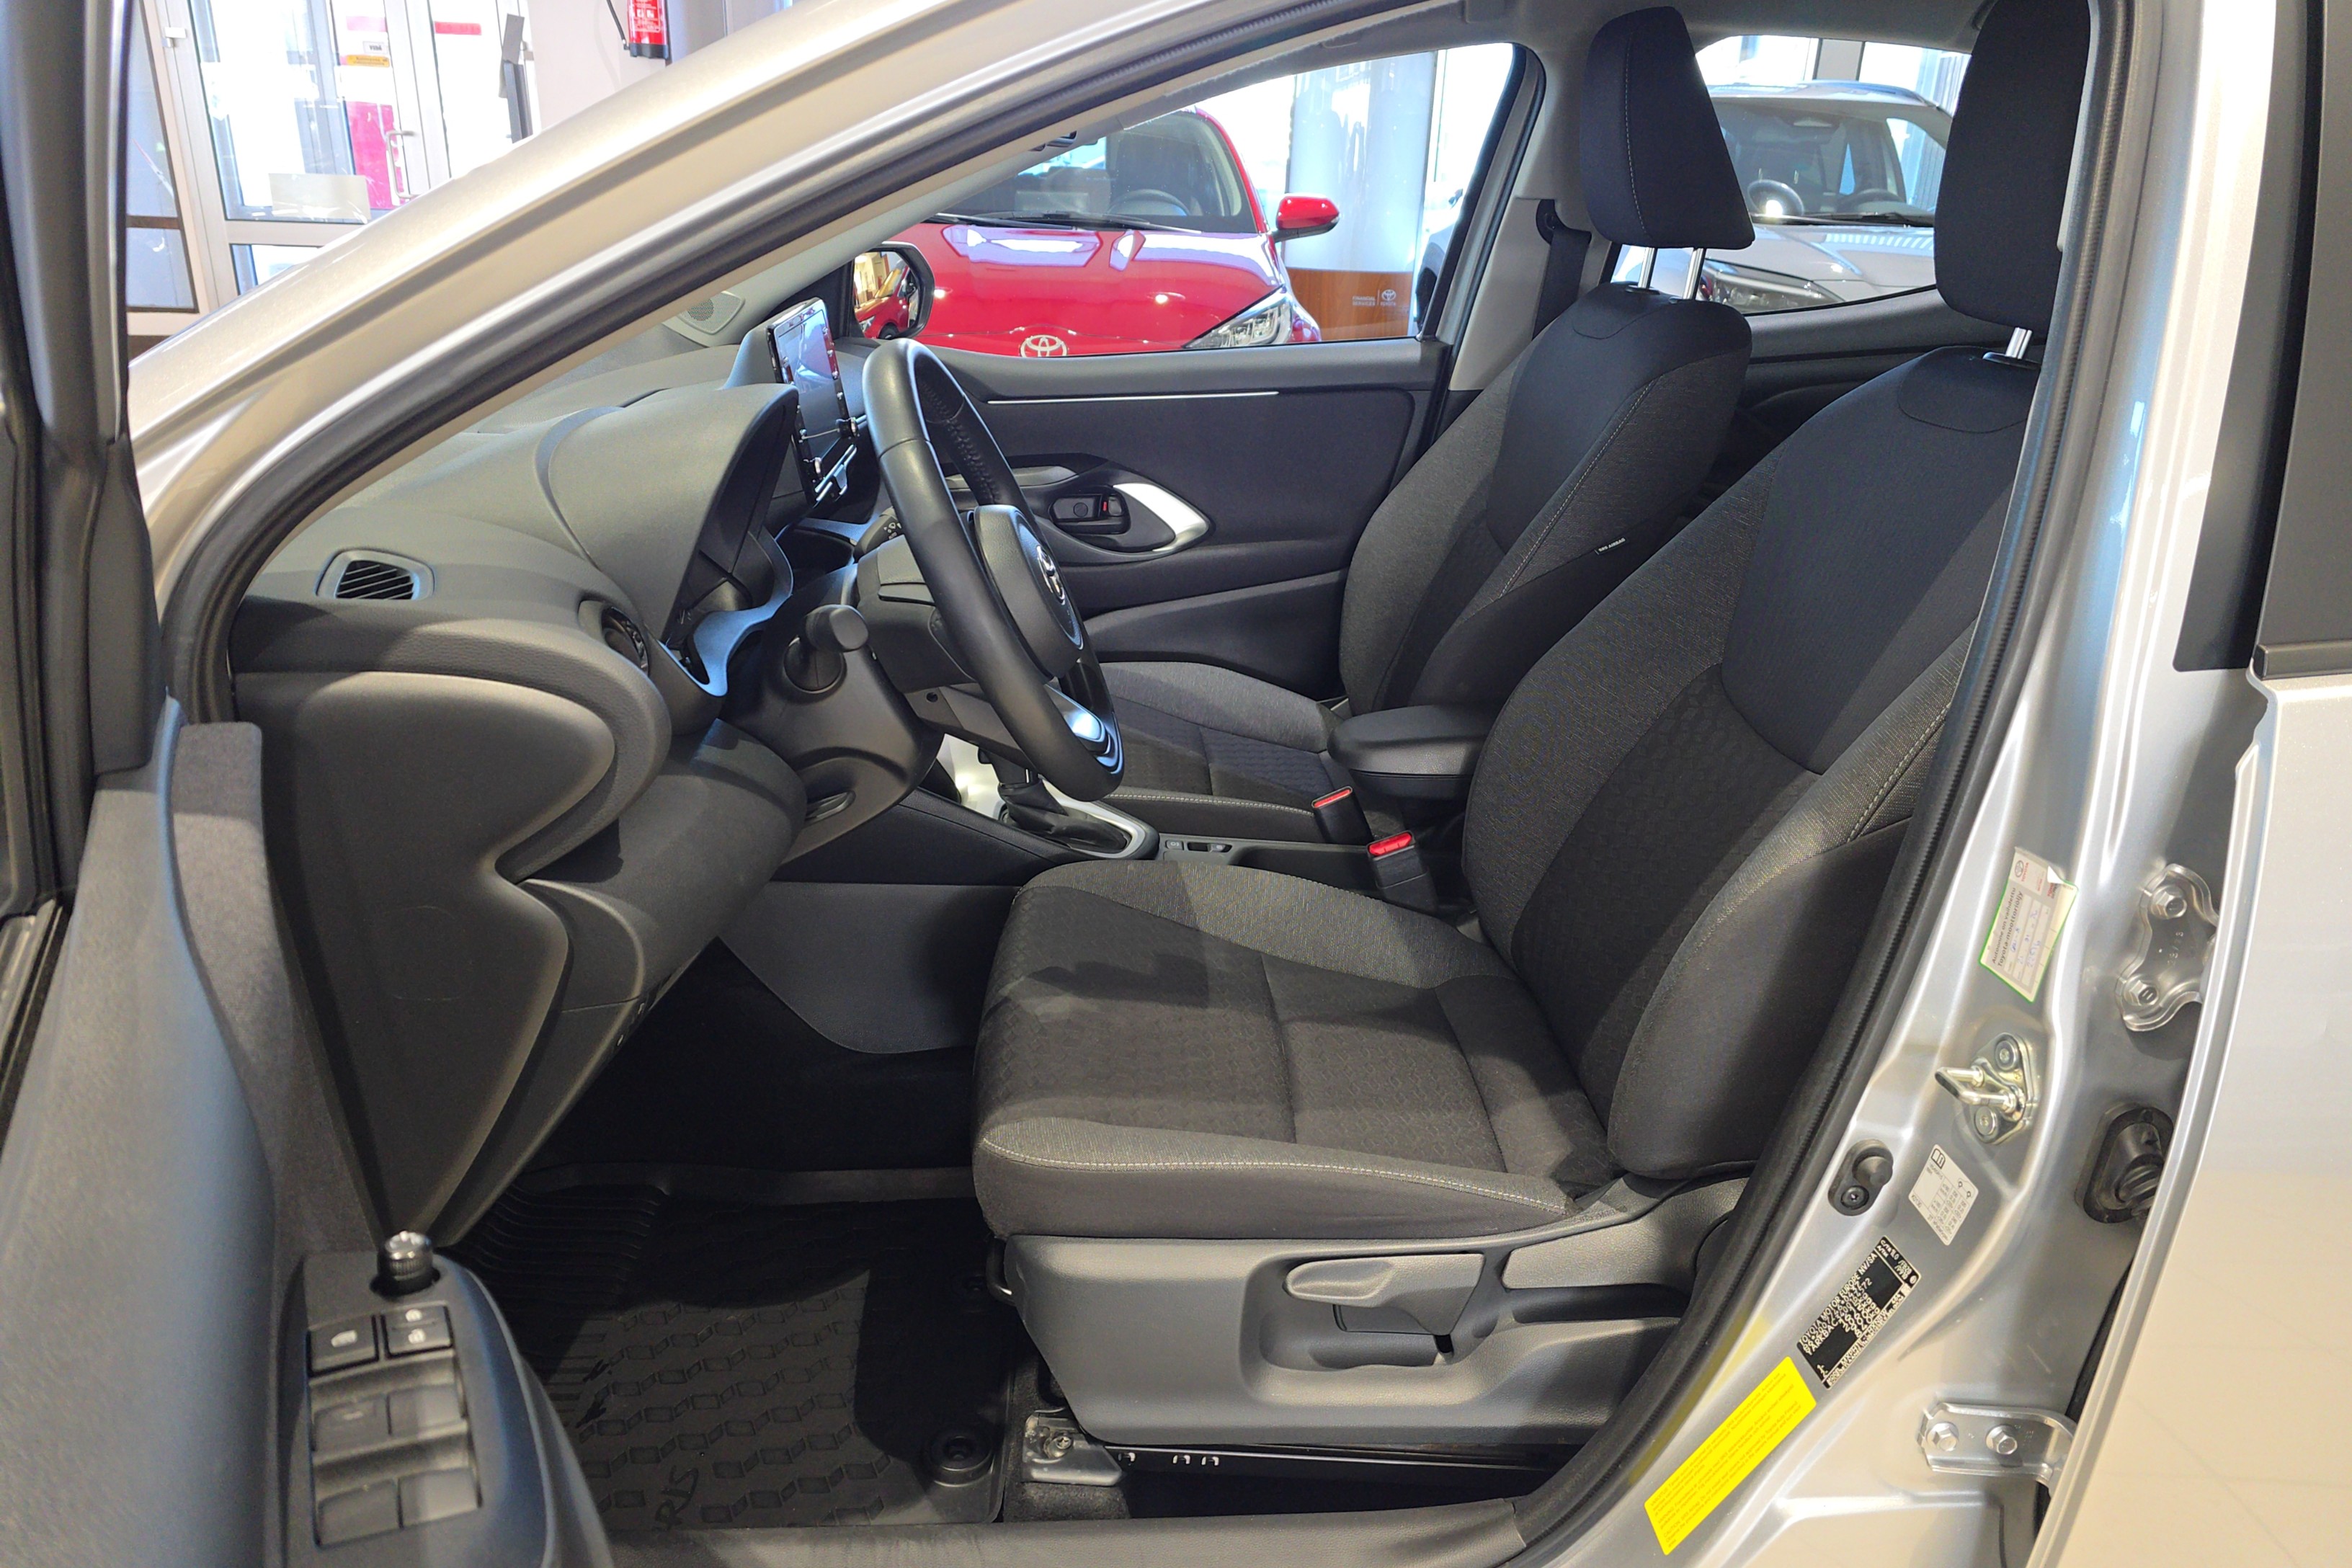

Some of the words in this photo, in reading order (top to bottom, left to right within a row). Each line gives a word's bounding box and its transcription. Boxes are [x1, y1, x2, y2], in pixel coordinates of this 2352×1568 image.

[1800, 1319, 1822, 1345] TOYOTA
[1821, 1296, 1841, 1320] MOTOR
[1840, 1273, 1861, 1297] EUROPE
[1858, 1252, 1878, 1275] NV/SA
